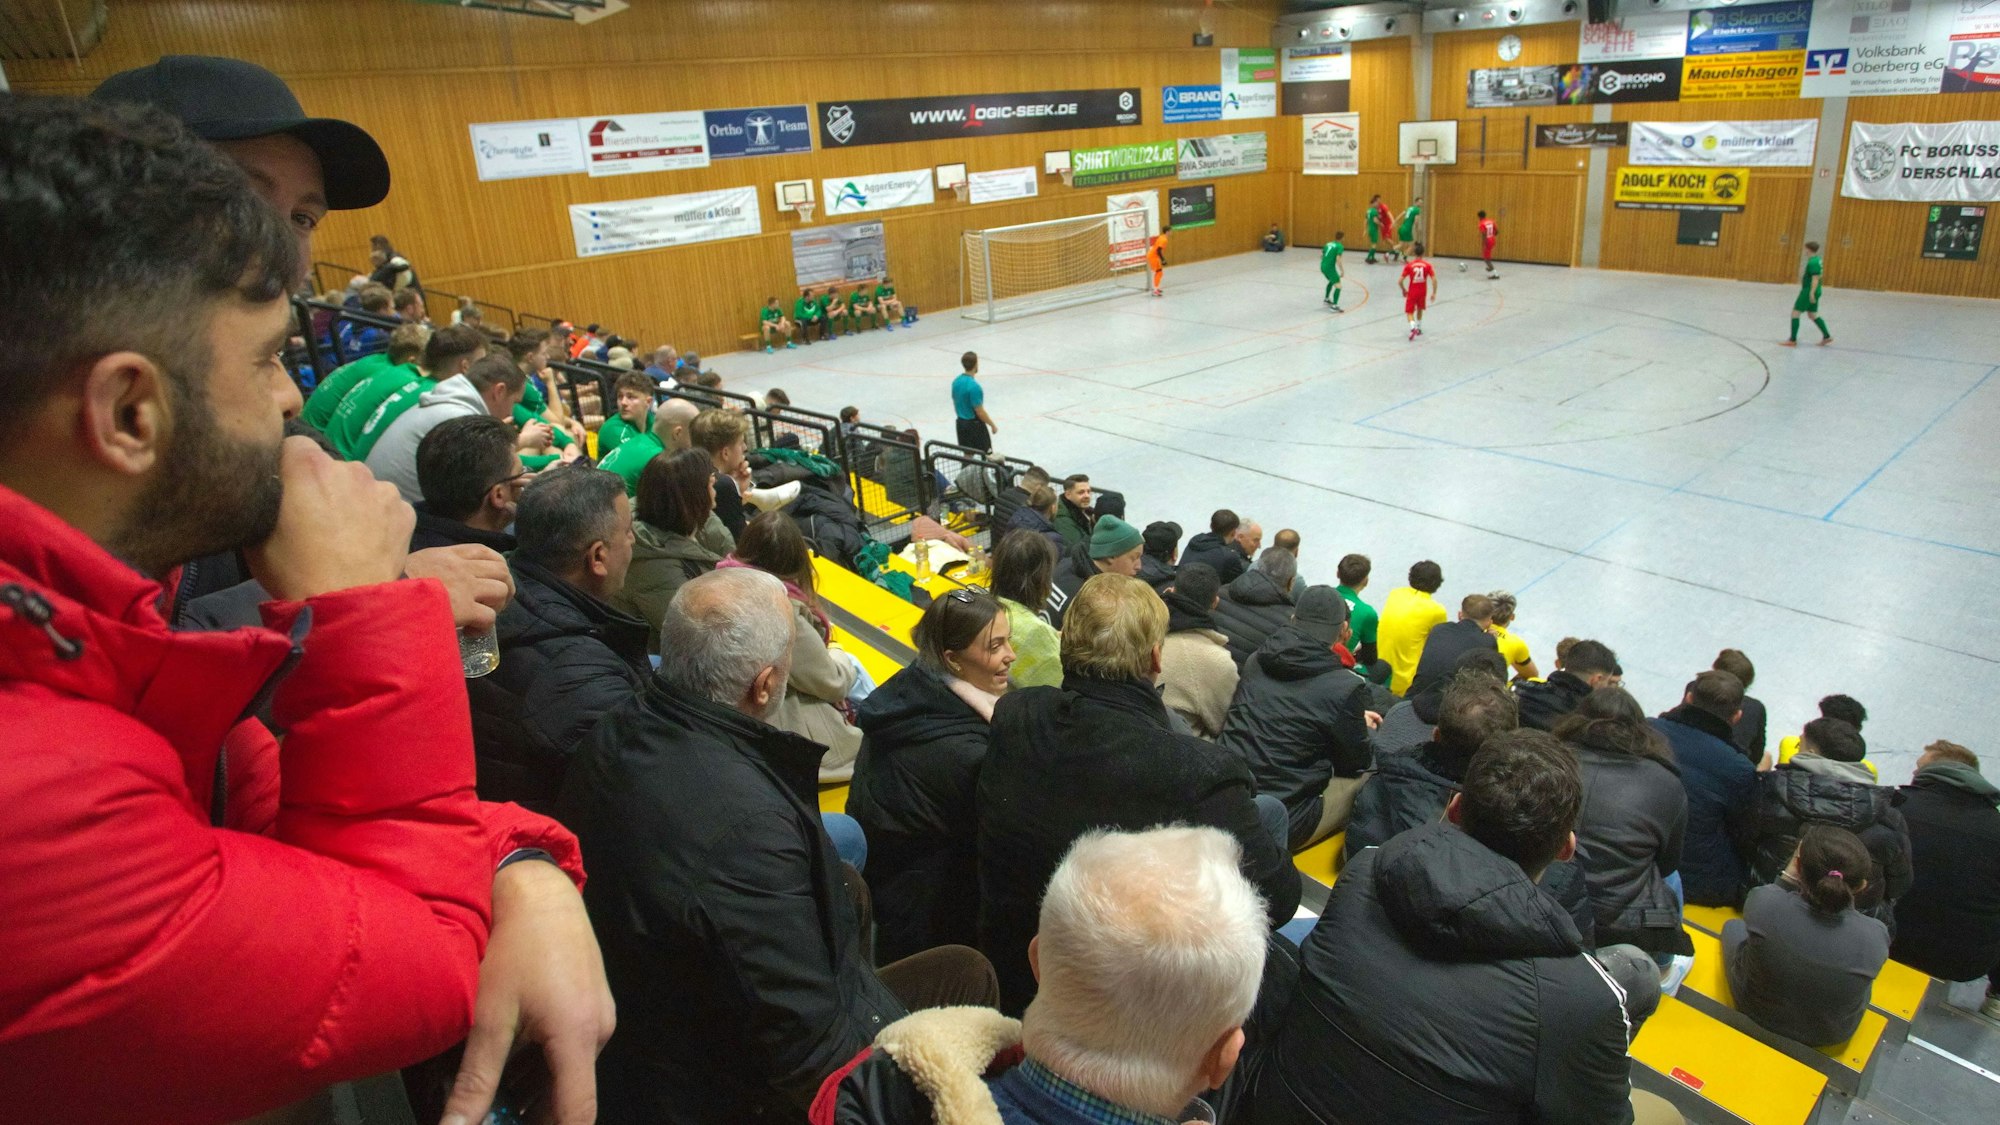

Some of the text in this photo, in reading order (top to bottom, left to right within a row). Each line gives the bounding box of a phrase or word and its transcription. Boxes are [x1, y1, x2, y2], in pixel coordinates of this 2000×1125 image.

[1713, 26, 1755, 36] Elektro
[1856, 44, 1926, 58] Volksbank
[1688, 66, 1798, 80] Mauelshagen
[1852, 58, 1944, 74] Oberberg eG
[1909, 77, 1926, 85] Weg
[1180, 90, 1221, 103] BRAND
[709, 123, 743, 137] Ortho
[777, 120, 807, 132] Team
[1074, 145, 1174, 171] SHIRTWORLD24.DE
[1900, 145, 1922, 158] FC
[864, 179, 917, 193] AggerEnergie
[1621, 173, 1707, 189] ADOLF KOCH
[1171, 204, 1193, 215] Selam
[1412, 266, 1424, 281] 21
